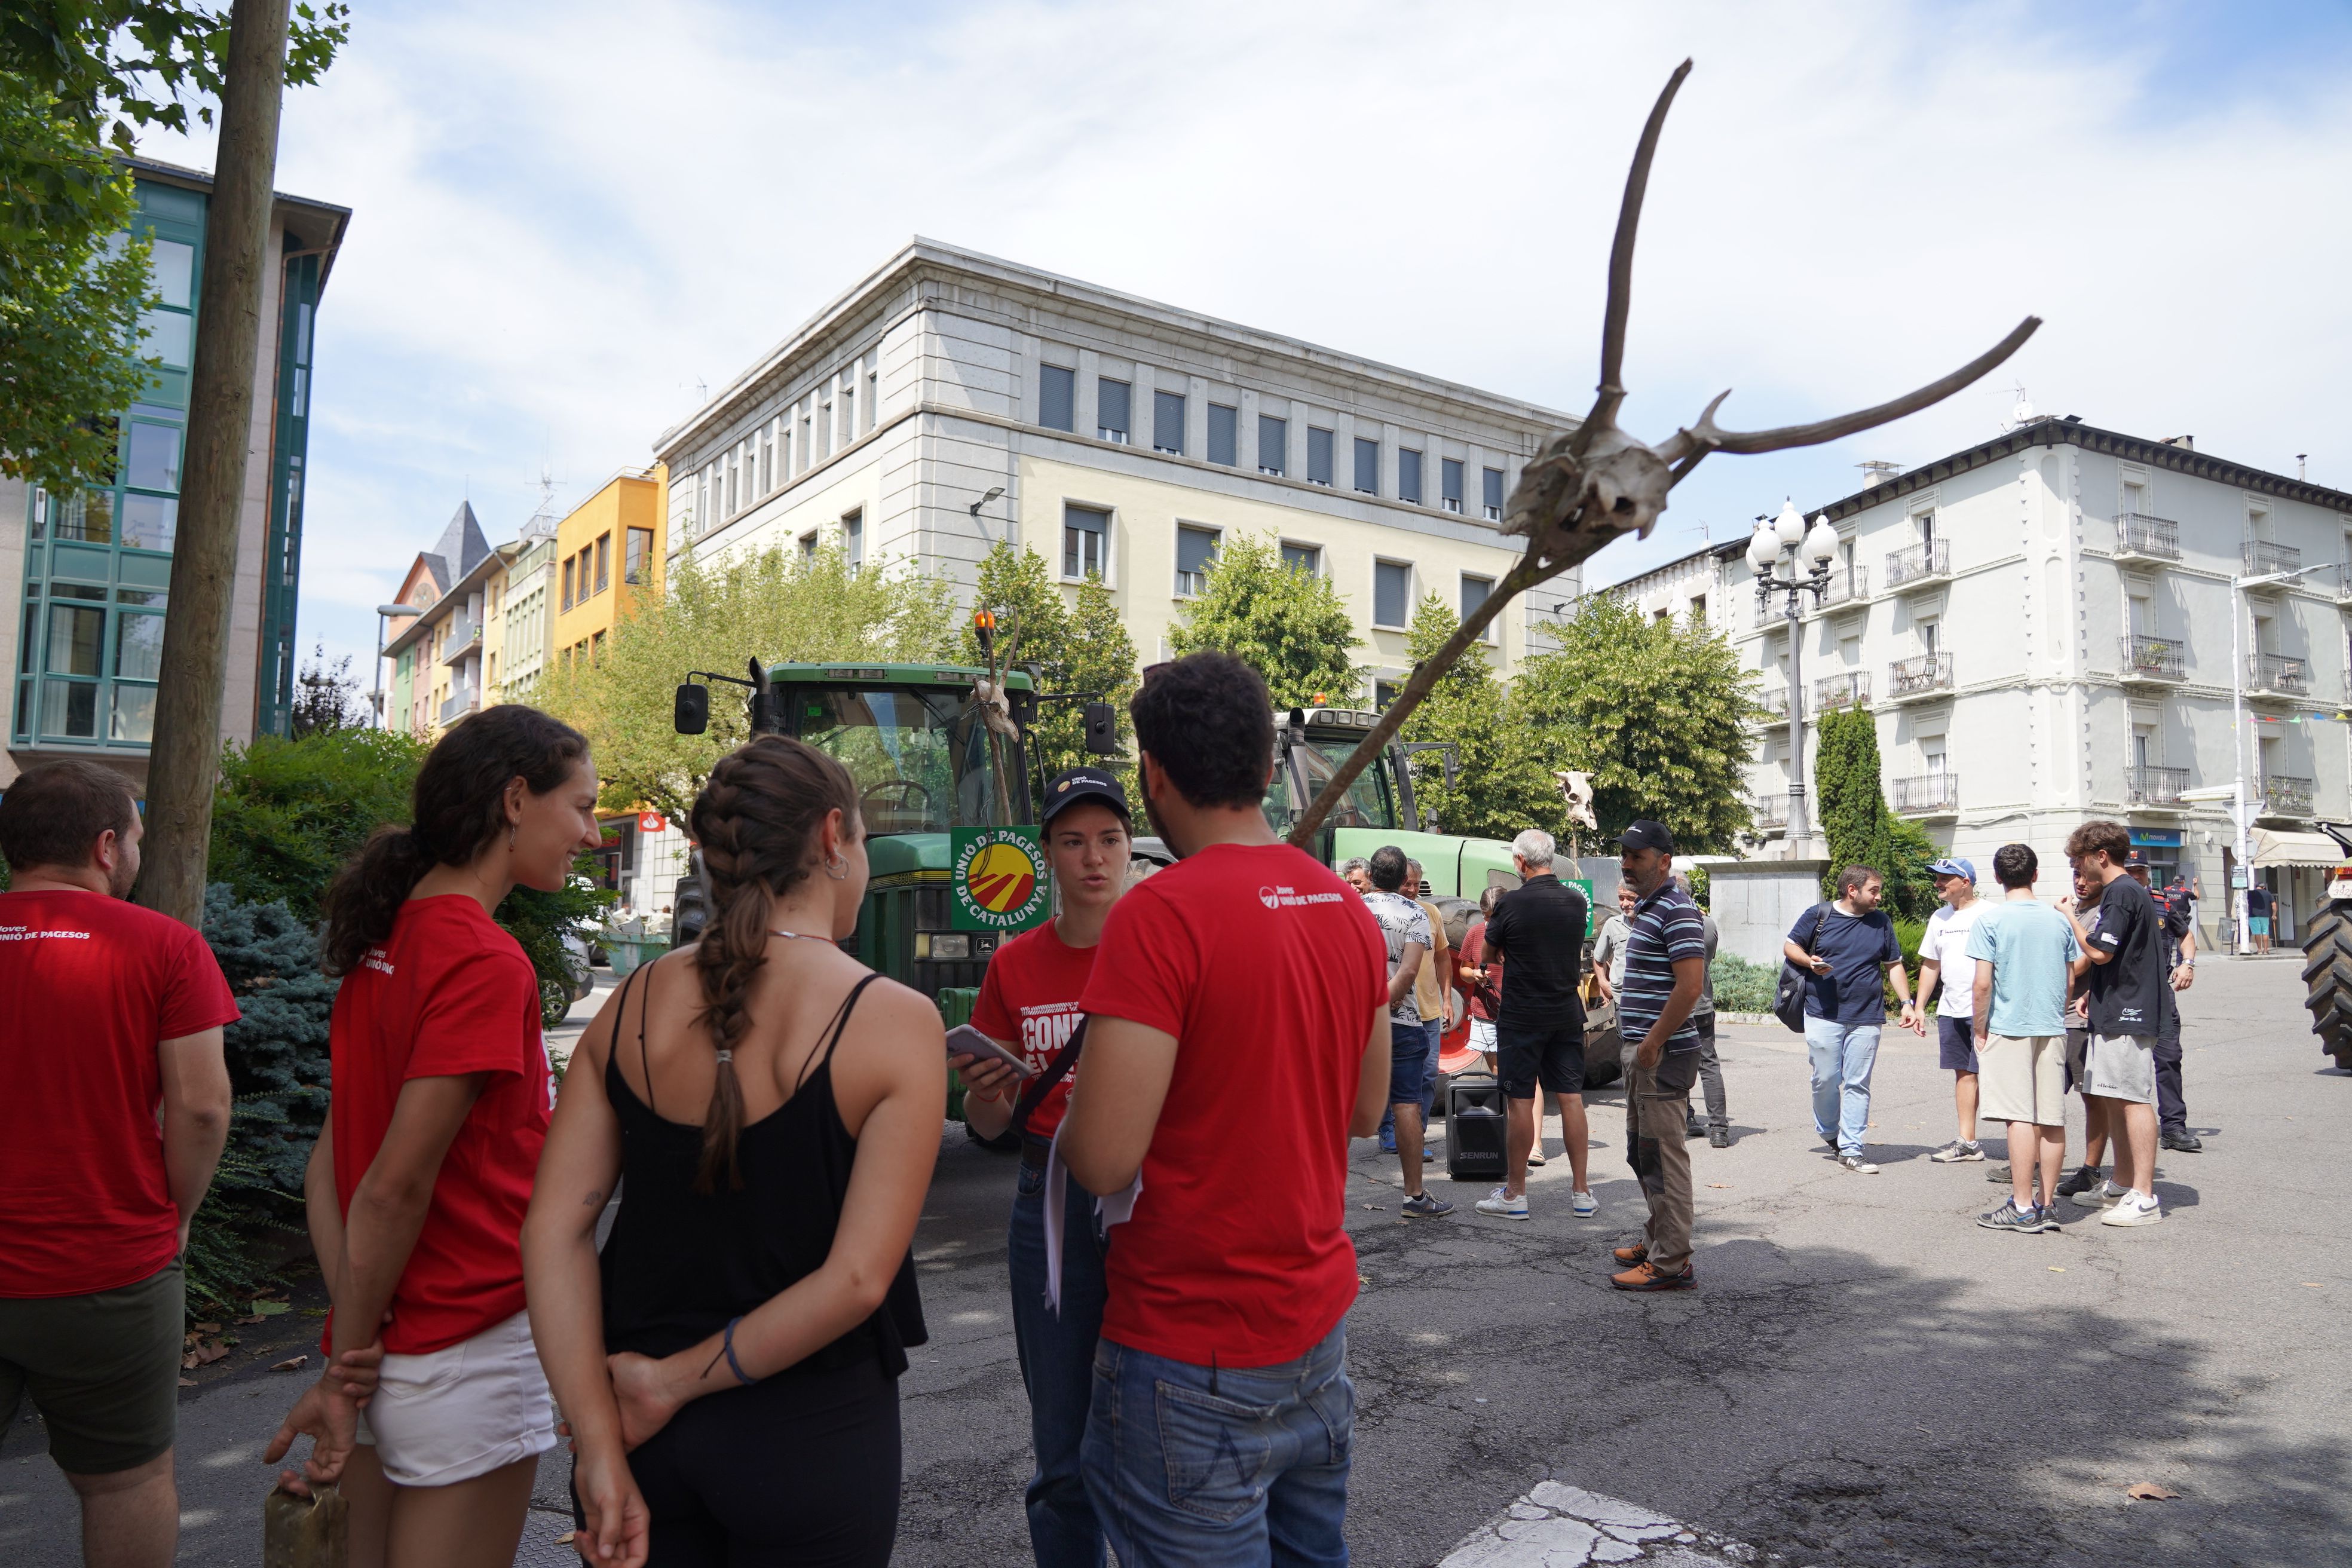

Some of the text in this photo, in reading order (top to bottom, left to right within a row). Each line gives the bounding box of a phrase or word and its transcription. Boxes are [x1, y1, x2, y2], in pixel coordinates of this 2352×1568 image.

[956, 830, 1048, 880] UNIÓ DE PAGESOS
[956, 885, 1048, 926] DE CATALUNYA
[1296, 895, 1308, 905] DE
[1568, 881, 1592, 909] PAGESOS
[24, 931, 38, 940] DE
[39, 930, 90, 939] PAGESOS
